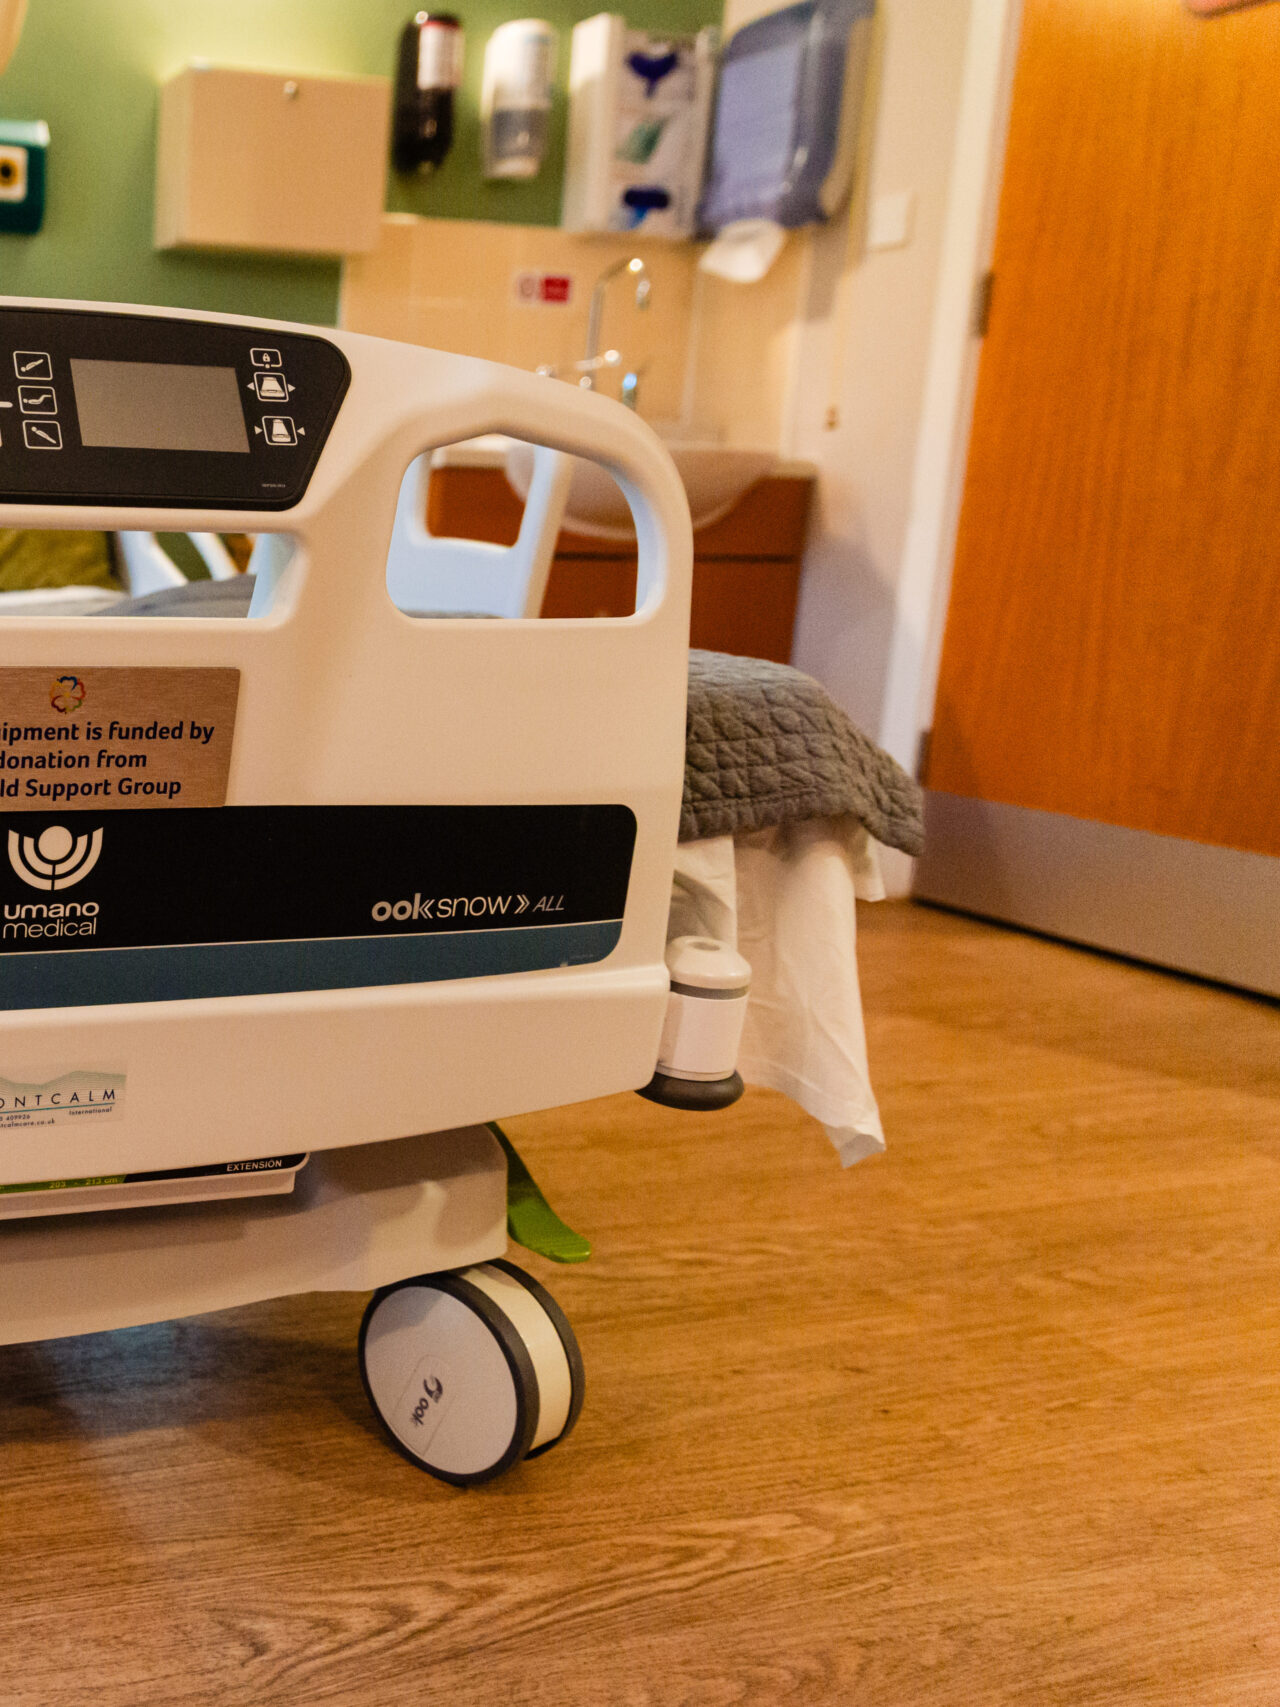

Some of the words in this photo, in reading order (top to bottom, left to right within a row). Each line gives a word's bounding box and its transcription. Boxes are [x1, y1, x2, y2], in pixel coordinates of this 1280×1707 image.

[86, 722, 103, 741] is
[108, 720, 184, 740] funded
[189, 720, 215, 745] by
[96, 750, 148, 769] from
[25, 778, 112, 801] Support
[117, 777, 182, 800] Group
[3, 901, 100, 920] umano
[532, 894, 565, 913] ALL
[2, 916, 97, 939] medical
